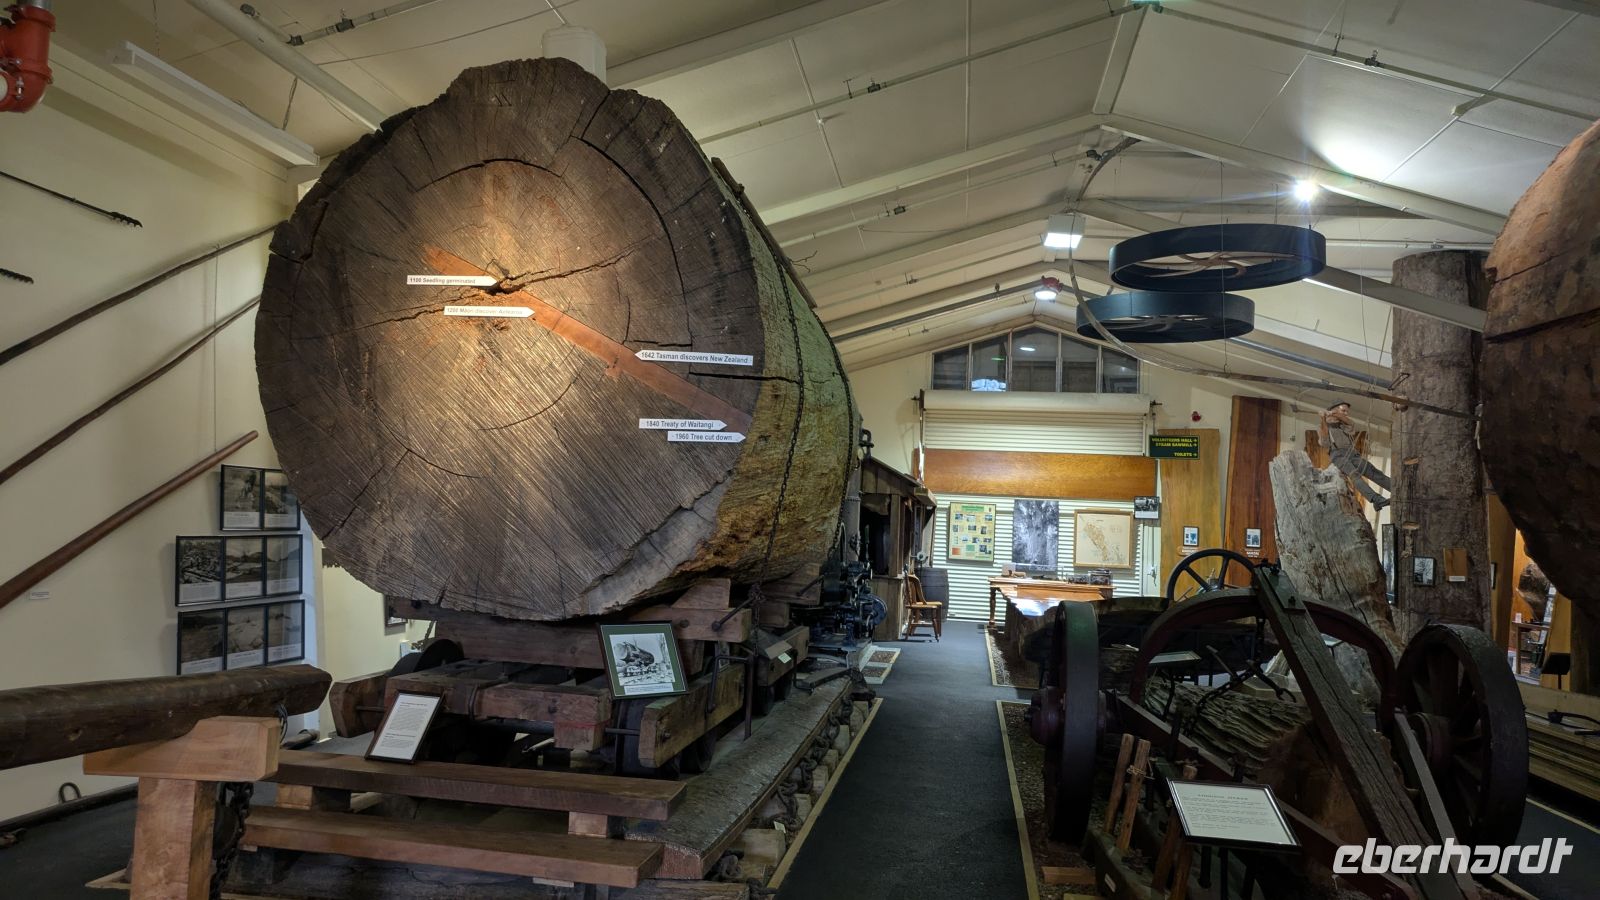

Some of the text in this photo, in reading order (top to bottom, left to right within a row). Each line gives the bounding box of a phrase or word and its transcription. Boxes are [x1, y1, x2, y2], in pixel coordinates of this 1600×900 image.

[422, 277, 445, 285] Seedling
[641, 351, 655, 359] 1642
[656, 352, 679, 360] Tasman
[680, 353, 709, 361] discovers
[724, 355, 748, 364] Zealand
[661, 420, 679, 429] Treaty
[688, 421, 714, 430] Waitangi
[675, 432, 690, 440] 1960
[704, 433, 714, 441] cut
[715, 433, 733, 441] down
